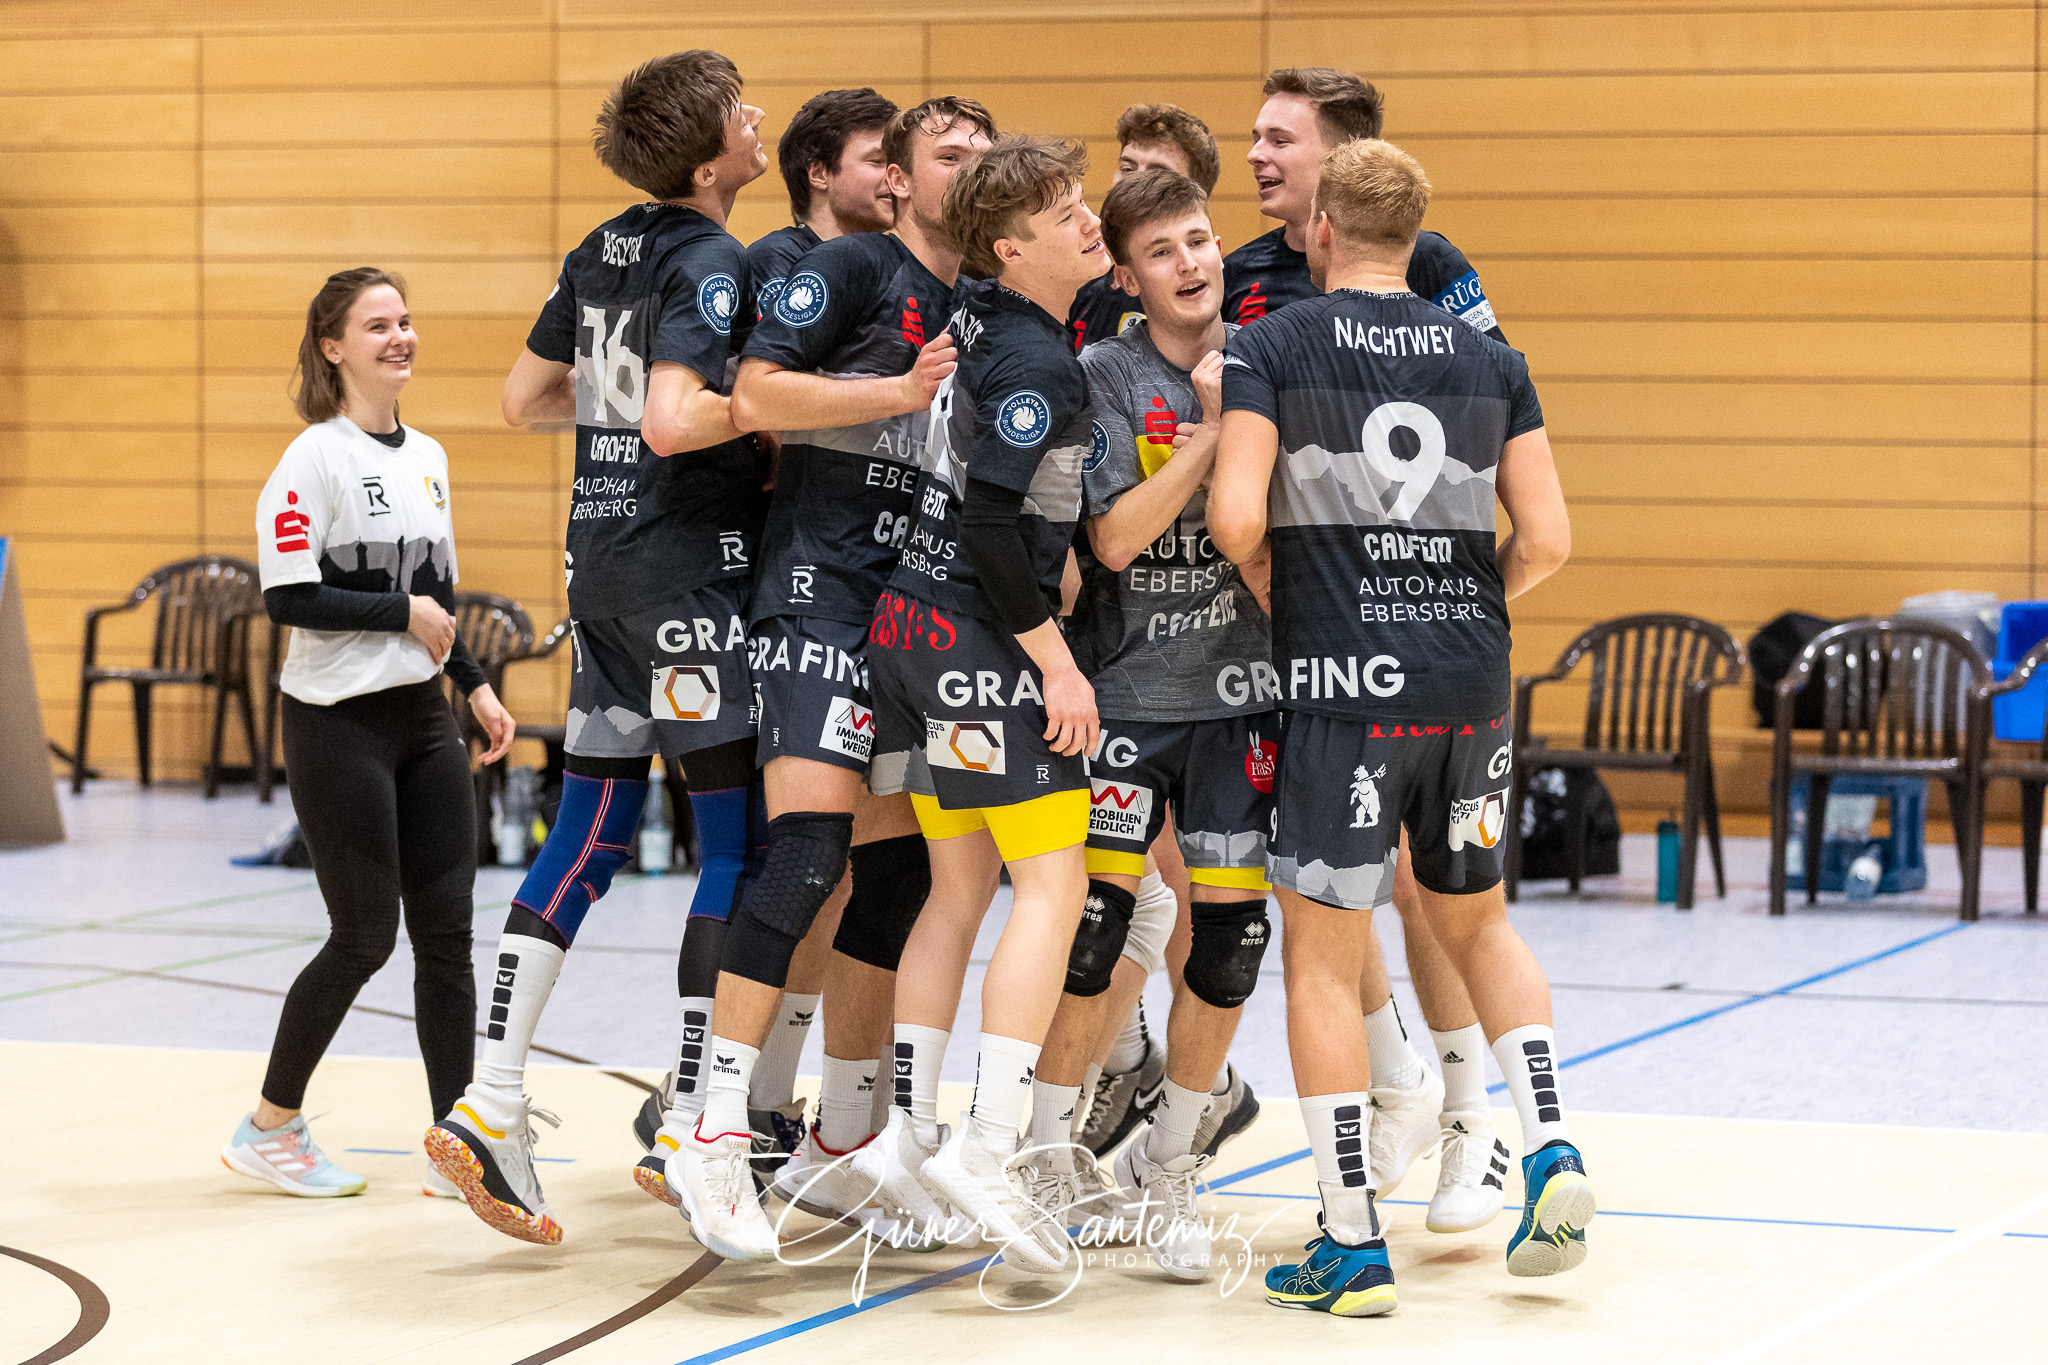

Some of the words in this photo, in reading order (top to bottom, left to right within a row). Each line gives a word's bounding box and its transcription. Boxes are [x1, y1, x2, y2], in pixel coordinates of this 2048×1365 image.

[1334, 316, 1455, 357] NACHTWEY
[582, 305, 645, 424] 16
[1006, 397, 1046, 421] VOLLEYBALL
[1002, 418, 1041, 441] BUNDESLIGA
[1361, 401, 1447, 522] 9
[835, 726, 875, 747] IMMOB
[713, 1064, 741, 1076] erima
